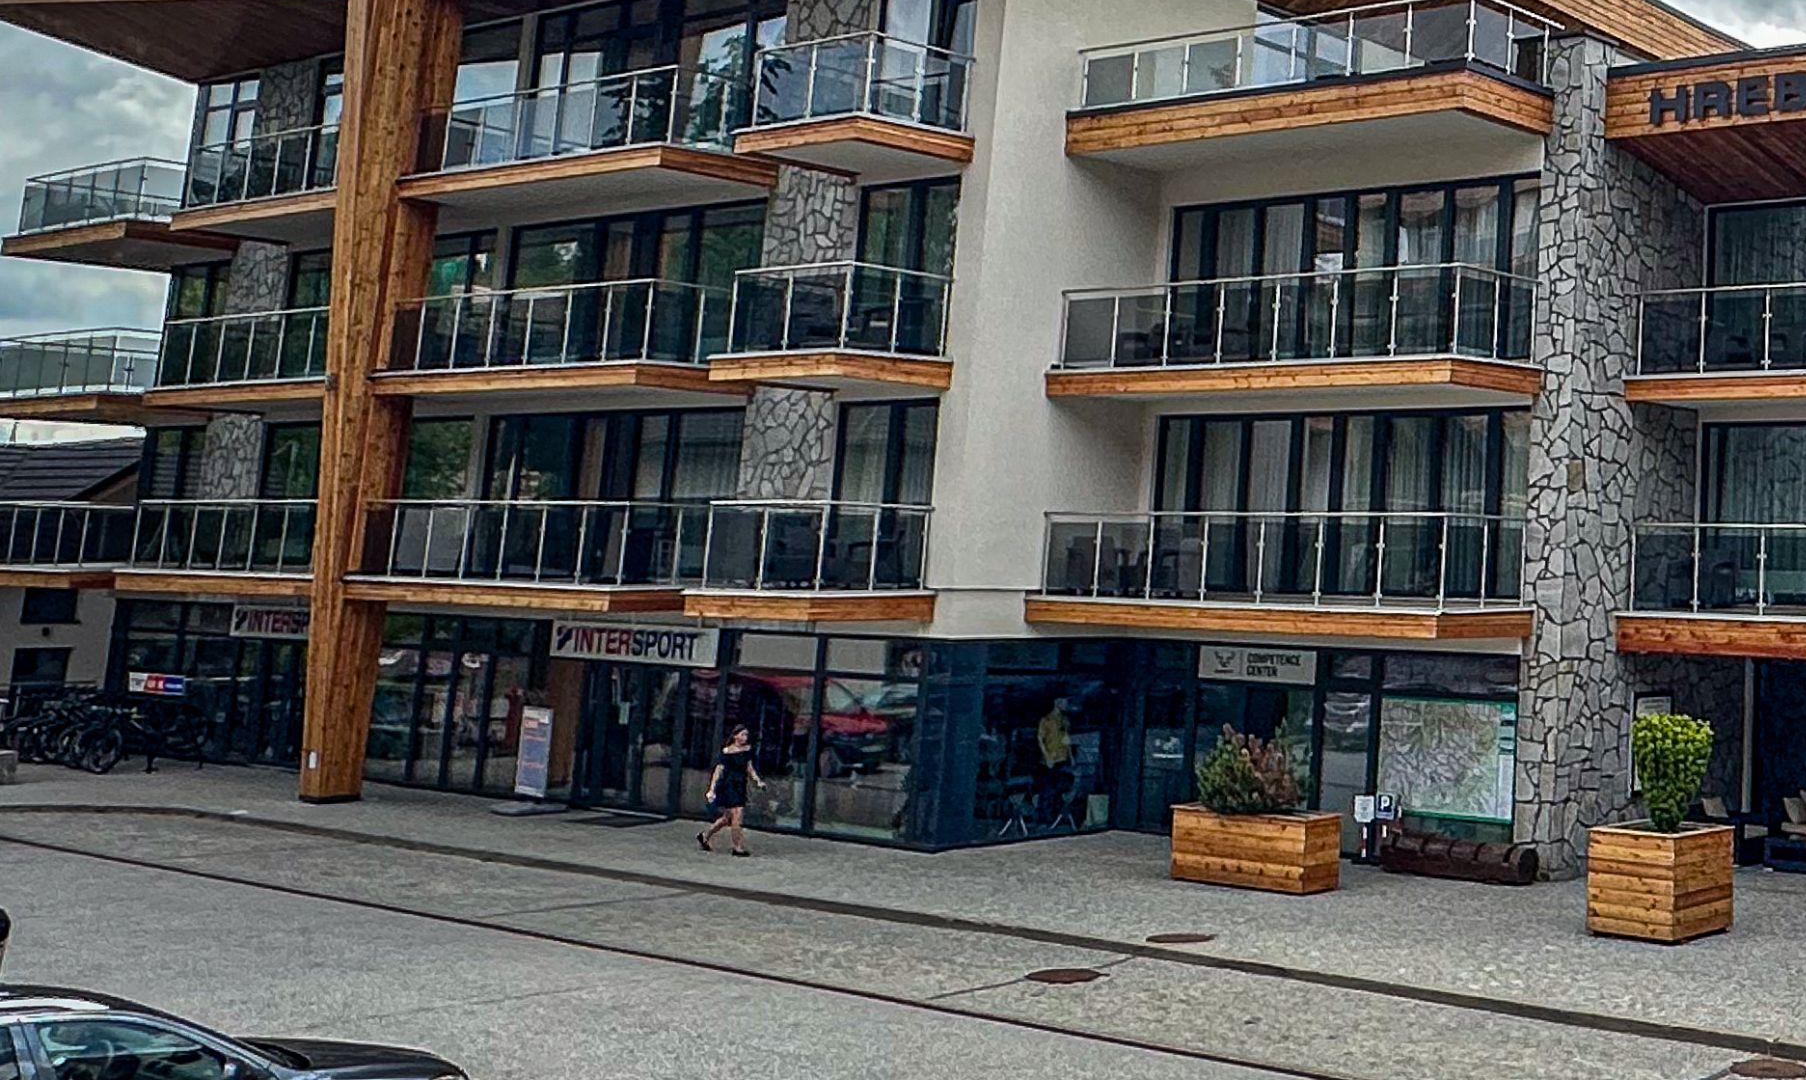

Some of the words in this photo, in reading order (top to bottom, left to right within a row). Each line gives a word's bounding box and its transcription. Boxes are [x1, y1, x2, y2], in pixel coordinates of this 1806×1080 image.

[247, 608, 311, 634] INTERSP
[574, 626, 700, 661] INTERSPORT
[1247, 653, 1302, 667] COMPETENCE
[1246, 665, 1279, 678] CENTER
[1380, 795, 1391, 811] P
